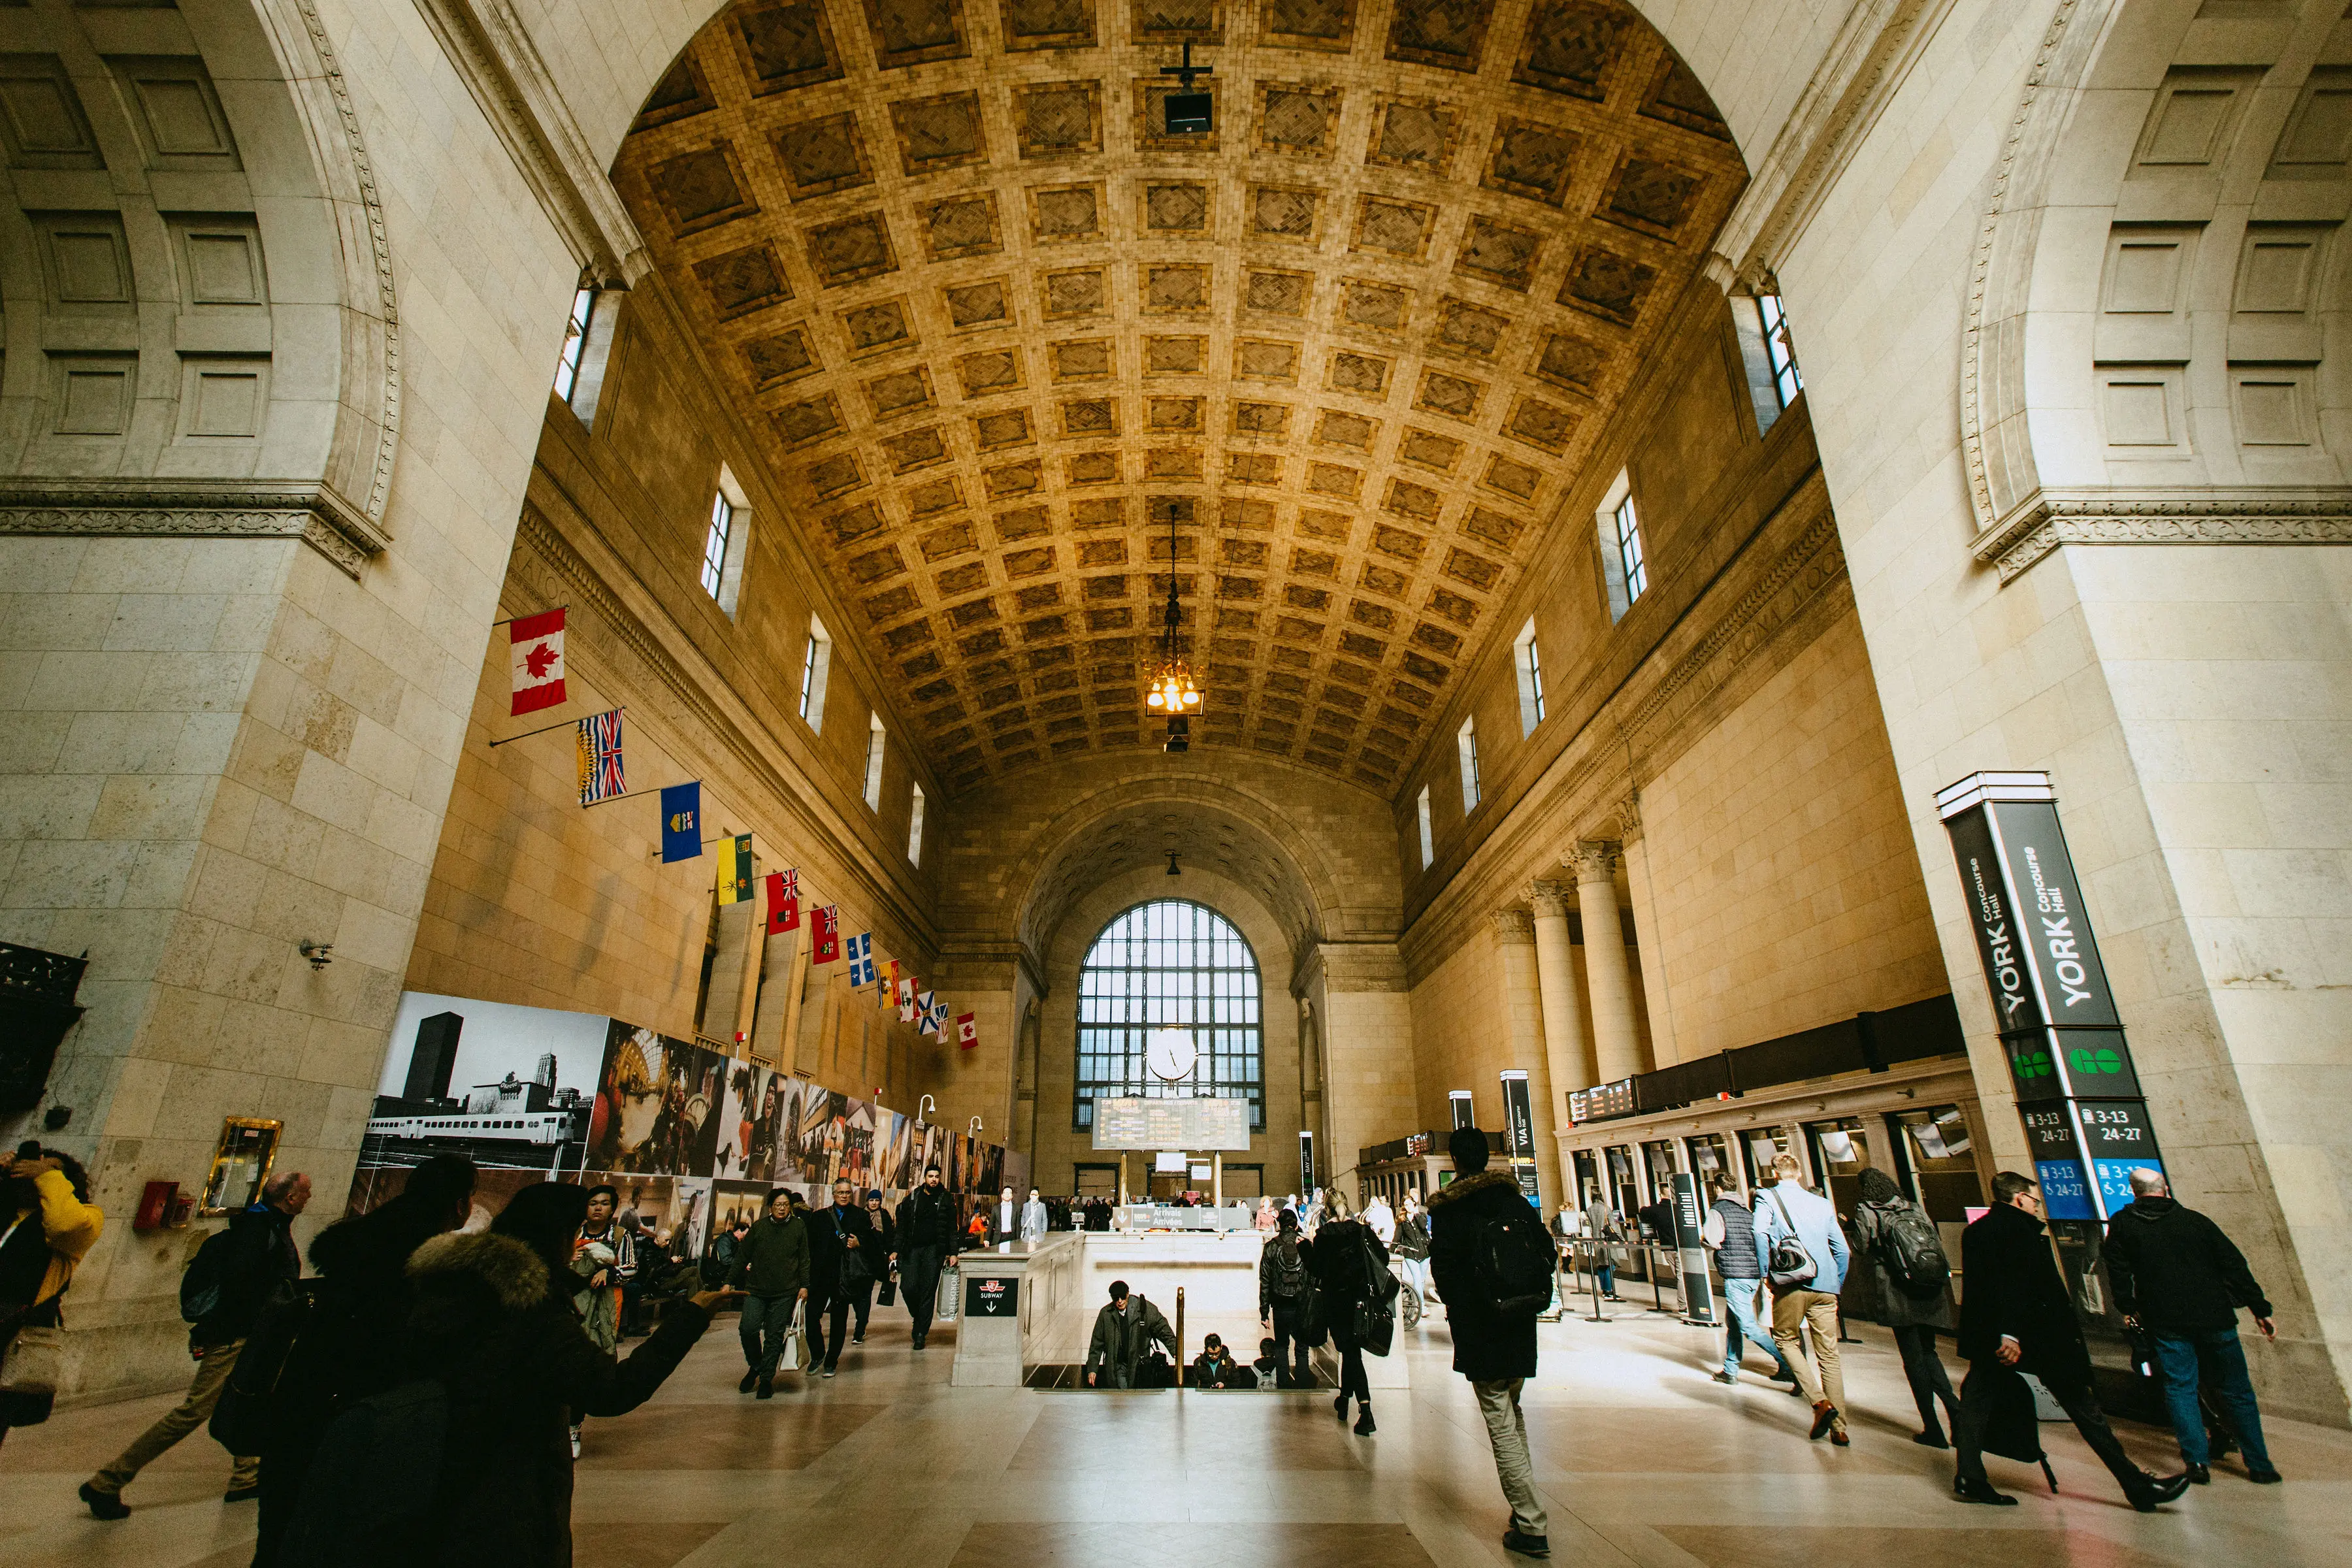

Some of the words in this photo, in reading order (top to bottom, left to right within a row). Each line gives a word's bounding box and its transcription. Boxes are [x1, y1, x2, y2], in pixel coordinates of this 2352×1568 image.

[2024, 847, 2051, 913] Concourse
[1970, 858, 1992, 923] Concourse
[1988, 893, 2002, 920] Hall
[2047, 887, 2066, 913] Hall
[1986, 922, 2025, 1014] YORK
[2041, 916, 2091, 1007] YORK
[2036, 1112, 2060, 1126] 3-13
[2096, 1111, 2129, 1124] 3-13
[1518, 1128, 1528, 1146] VIA
[2040, 1128, 2070, 1142] 24-27
[2101, 1128, 2142, 1140] 24-27
[2050, 1166, 2075, 1179] 3-13
[2055, 1184, 2083, 1196] 24-27
[1153, 1217, 1183, 1226] Arrivées
